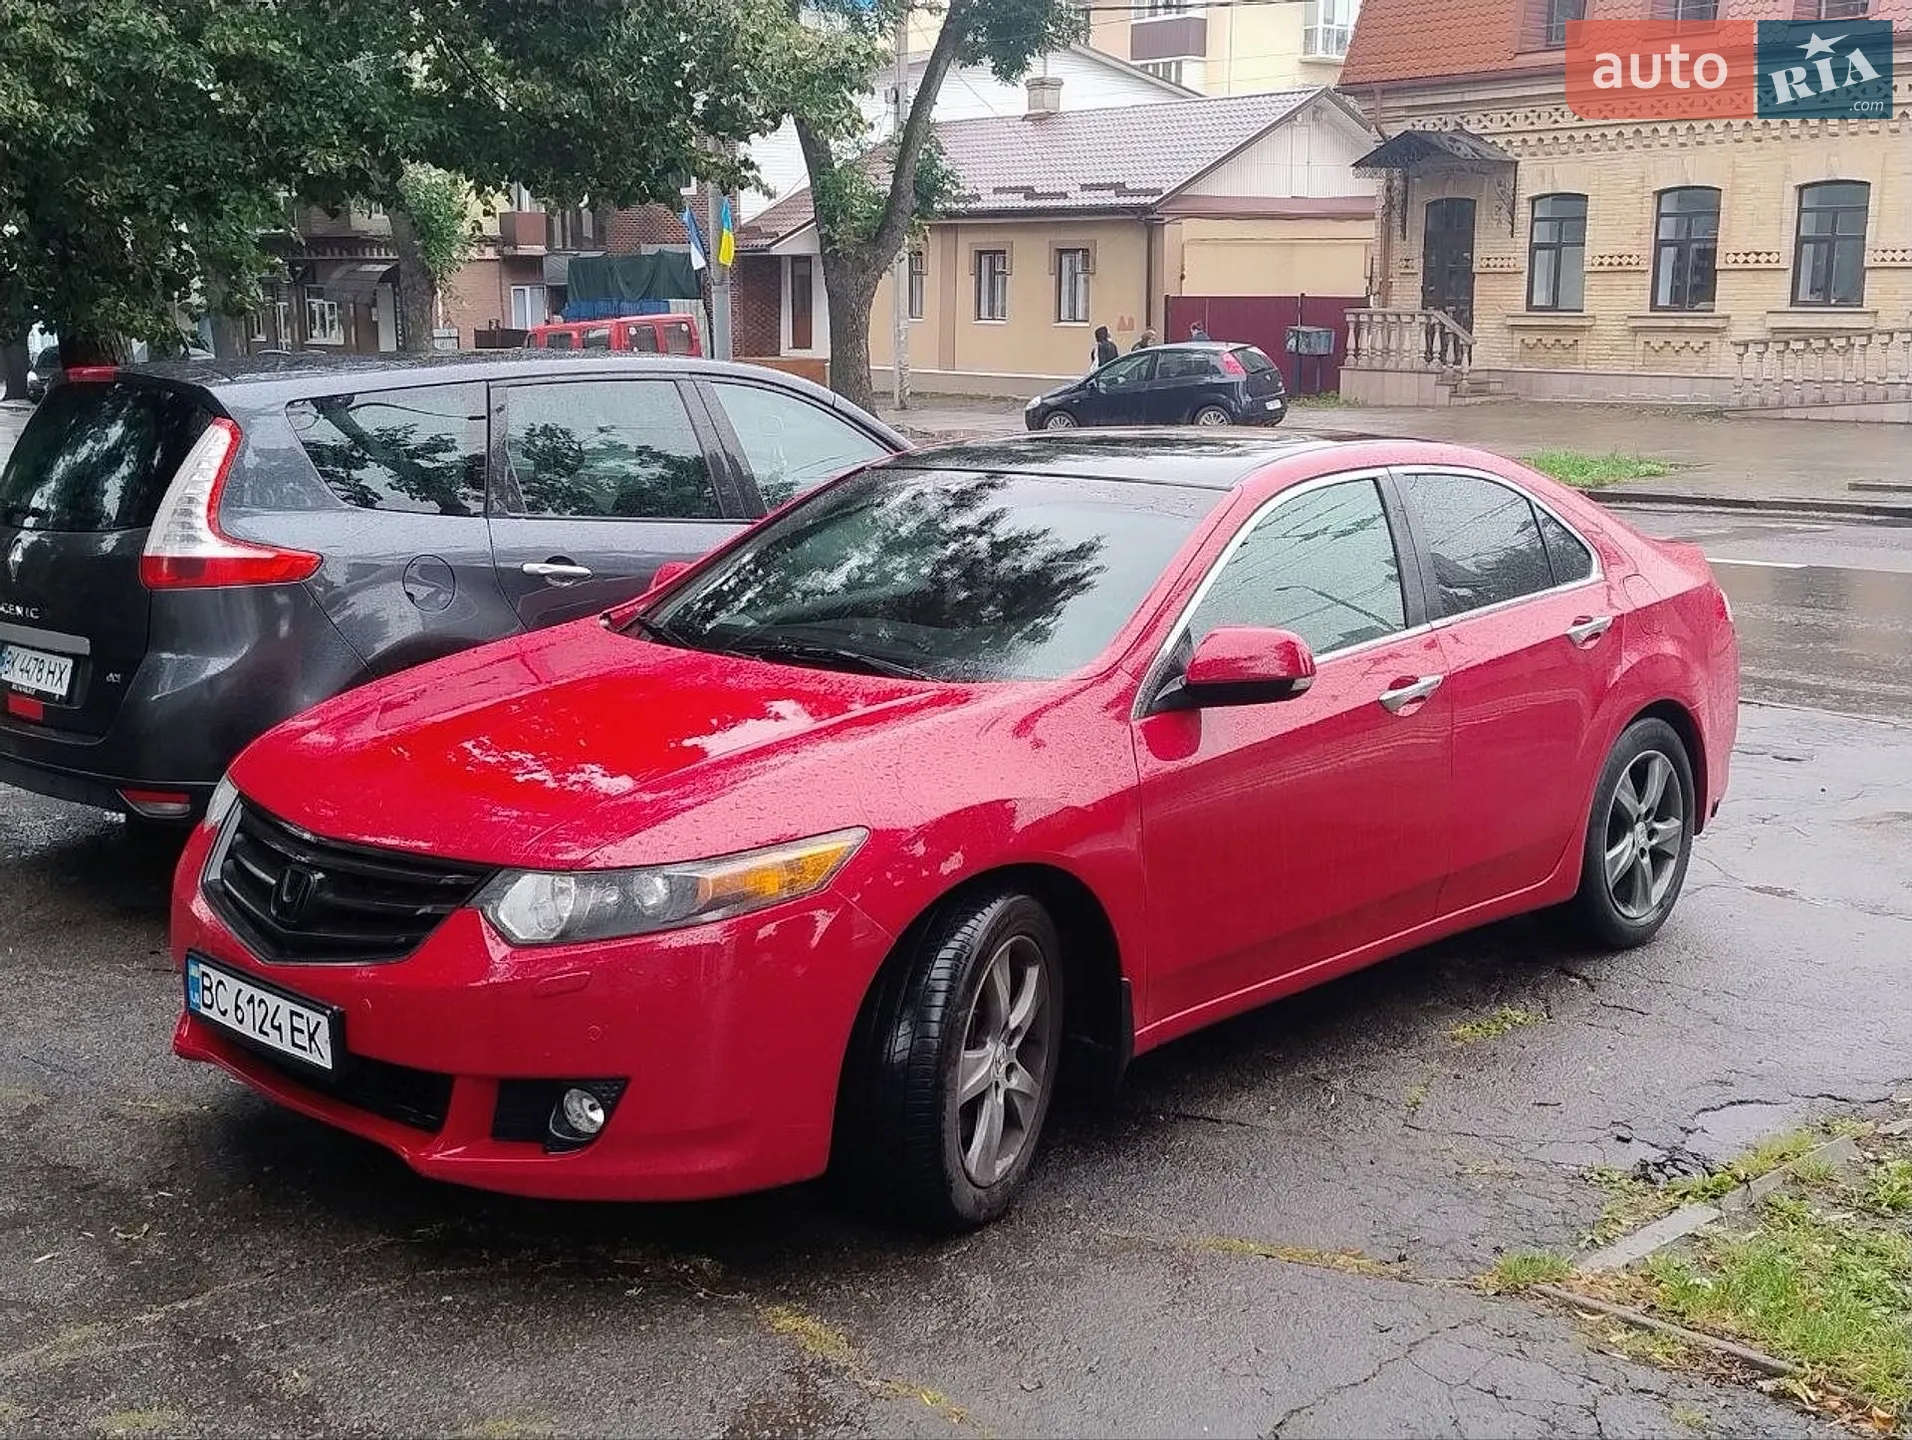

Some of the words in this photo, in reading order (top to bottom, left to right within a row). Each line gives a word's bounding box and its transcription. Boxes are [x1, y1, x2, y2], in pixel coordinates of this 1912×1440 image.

[19, 654, 45, 683] 4478
[45, 660, 68, 689] HX
[201, 970, 228, 1017] BC
[234, 988, 284, 1044] 6124
[289, 1008, 326, 1060] EK
